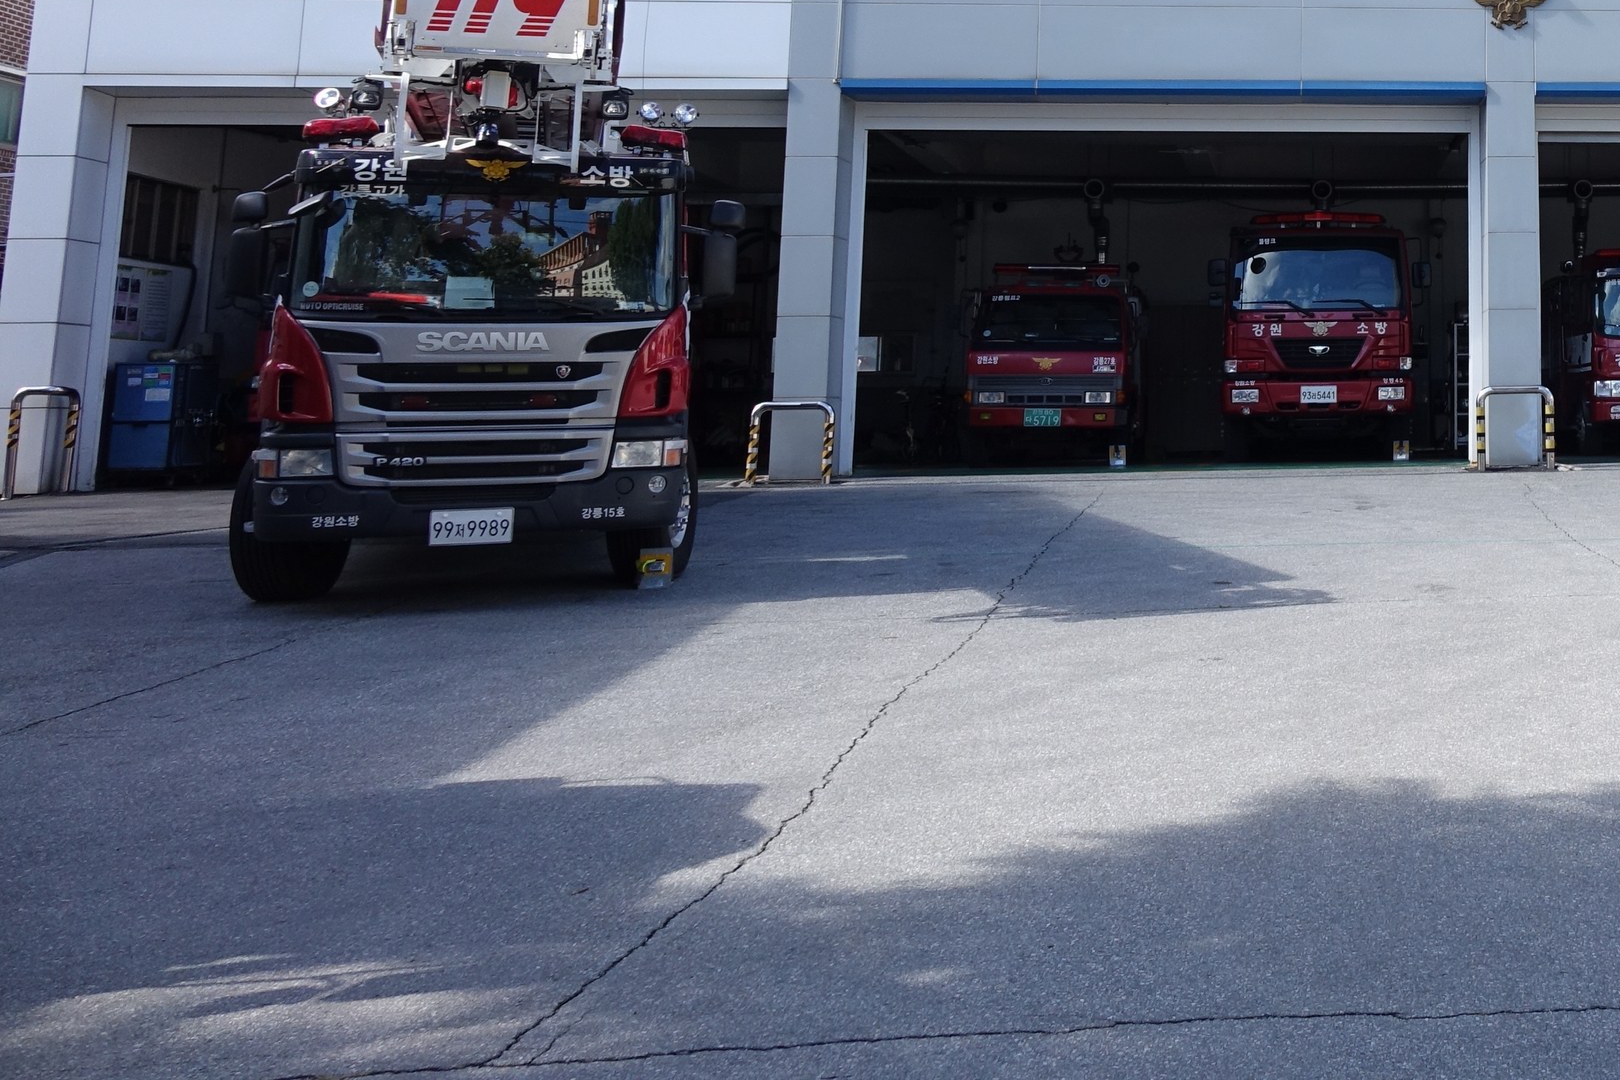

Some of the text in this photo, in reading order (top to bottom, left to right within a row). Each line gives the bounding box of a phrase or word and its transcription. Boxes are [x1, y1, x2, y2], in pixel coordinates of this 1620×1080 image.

[353, 158, 634, 188] 강원 소방
[1252, 321, 1388, 337] 강원 소방
[416, 331, 550, 352] SCANIA
[389, 456, 425, 467] 420
[581, 506, 626, 520] 강릉15호
[311, 515, 360, 529] 강원소방
[433, 519, 510, 539] 99저9989
